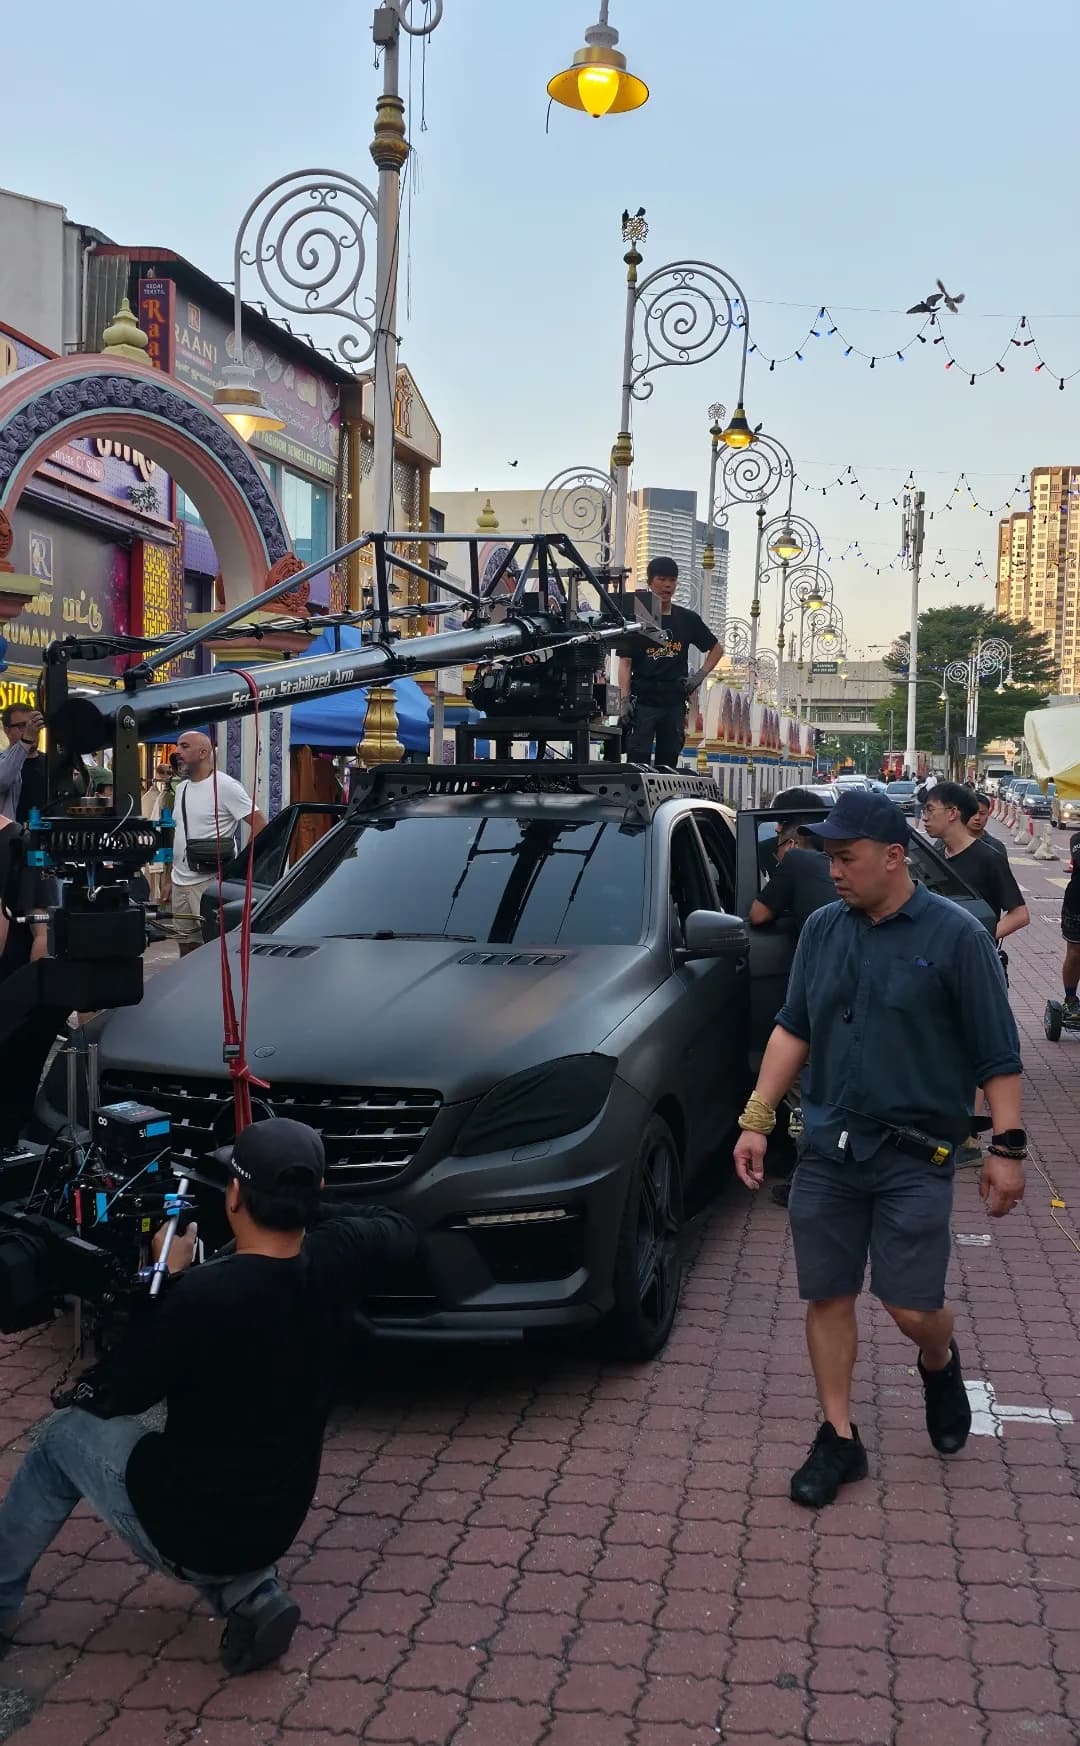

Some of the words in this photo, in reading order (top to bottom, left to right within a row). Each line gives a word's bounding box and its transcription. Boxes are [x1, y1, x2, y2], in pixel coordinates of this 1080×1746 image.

[0, 681, 36, 710] Silks
[280, 671, 331, 695] Stabilized
[334, 669, 354, 685] Arm
